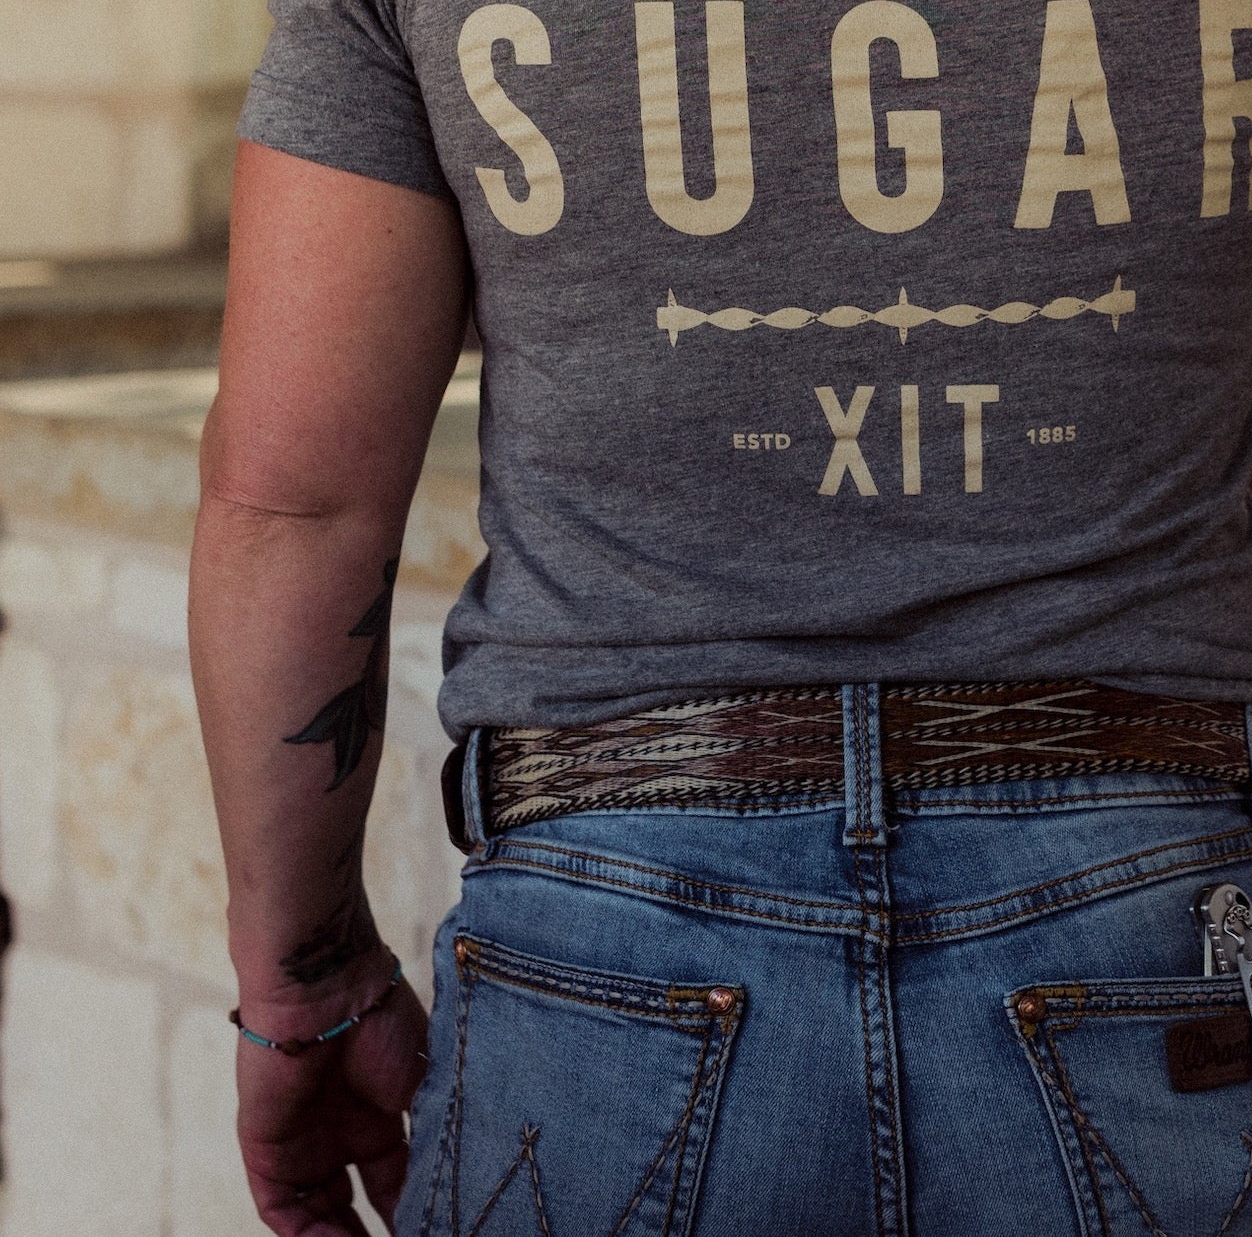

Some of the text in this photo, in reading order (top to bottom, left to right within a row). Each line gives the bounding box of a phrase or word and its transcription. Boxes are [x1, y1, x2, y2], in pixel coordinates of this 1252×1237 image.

[732, 383, 1078, 498] ESTD XIT 1885
